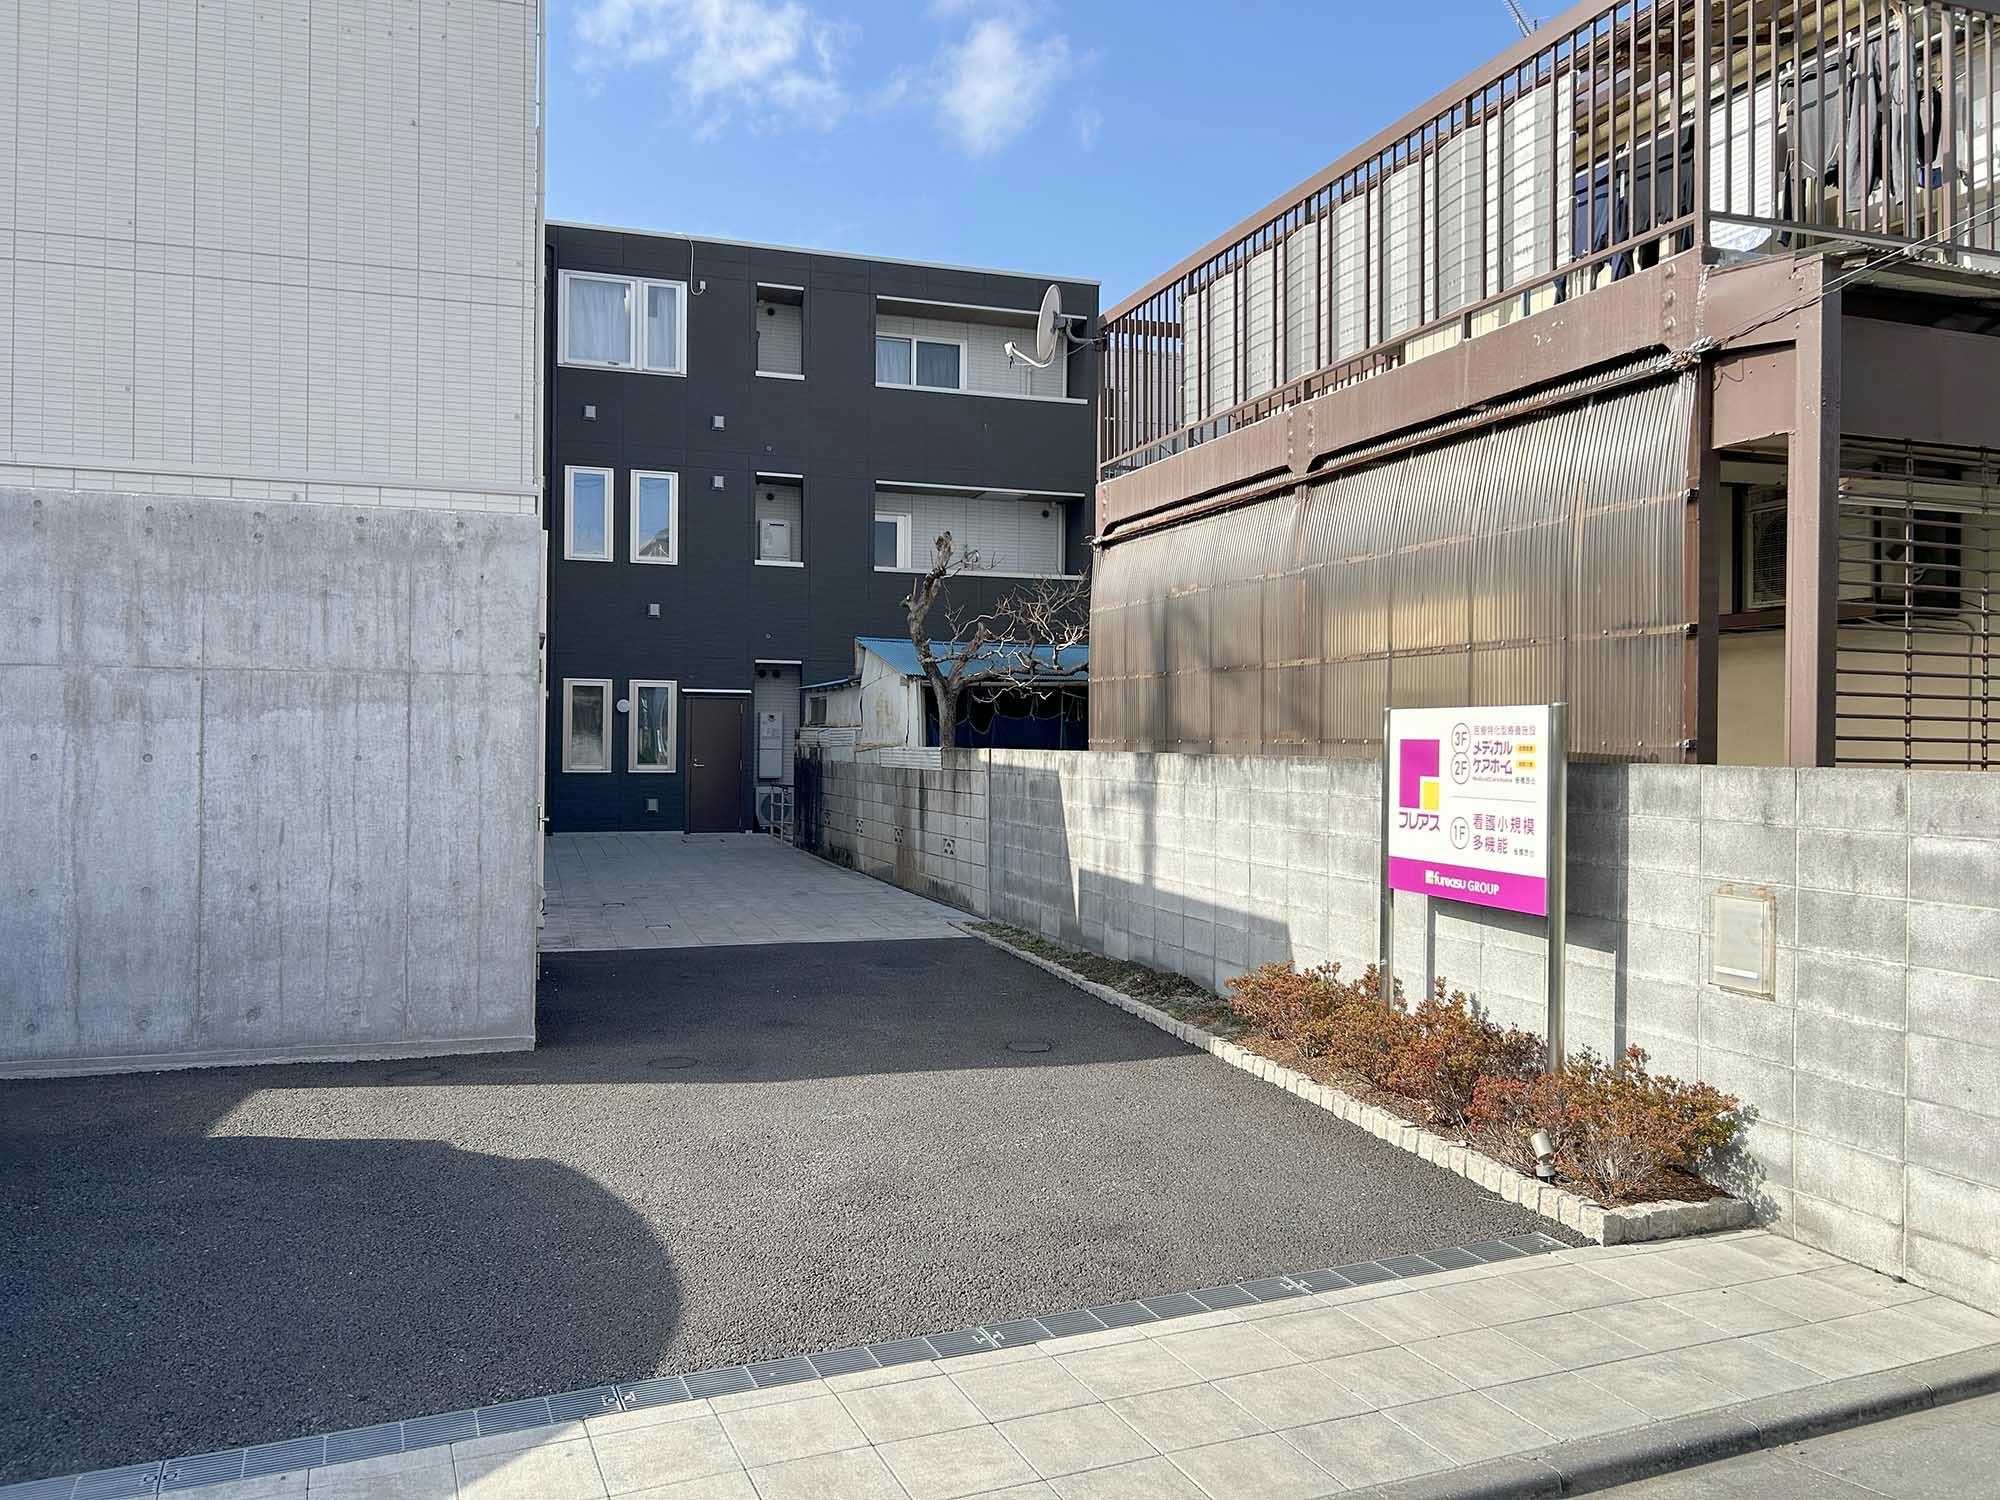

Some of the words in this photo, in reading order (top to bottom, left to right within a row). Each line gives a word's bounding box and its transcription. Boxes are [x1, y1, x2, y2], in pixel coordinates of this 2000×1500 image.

[1454, 731, 1467, 746] 3F
[1472, 740, 1513, 755] メディカル
[1454, 761, 1467, 775] 2F
[1472, 758, 1513, 774] ケアホーム
[1398, 811, 1440, 831] フレアス
[1472, 813, 1535, 835] 看護小規模
[1454, 825, 1466, 841] 1F
[1472, 834, 1508, 854] 多機能
[1467, 879, 1500, 895] GROUP
